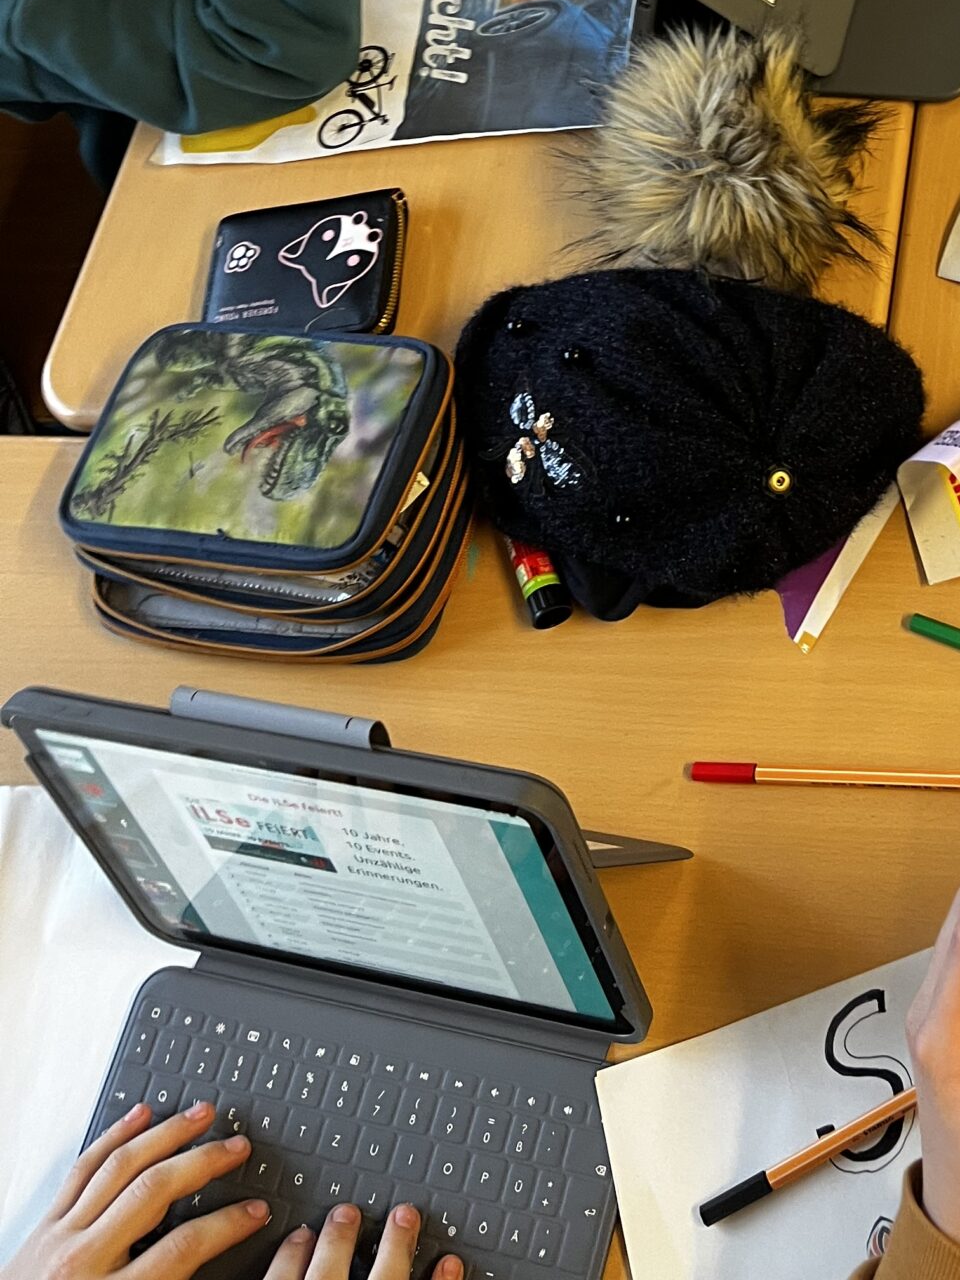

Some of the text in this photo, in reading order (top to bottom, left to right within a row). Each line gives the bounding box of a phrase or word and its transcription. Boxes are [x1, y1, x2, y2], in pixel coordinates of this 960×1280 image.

[340, 826, 405, 848] 10 Jahre.
[345, 839, 415, 862] 10 Events.
[353, 853, 422, 876] Unzählige
[346, 864, 444, 893] Erinnerungen.
